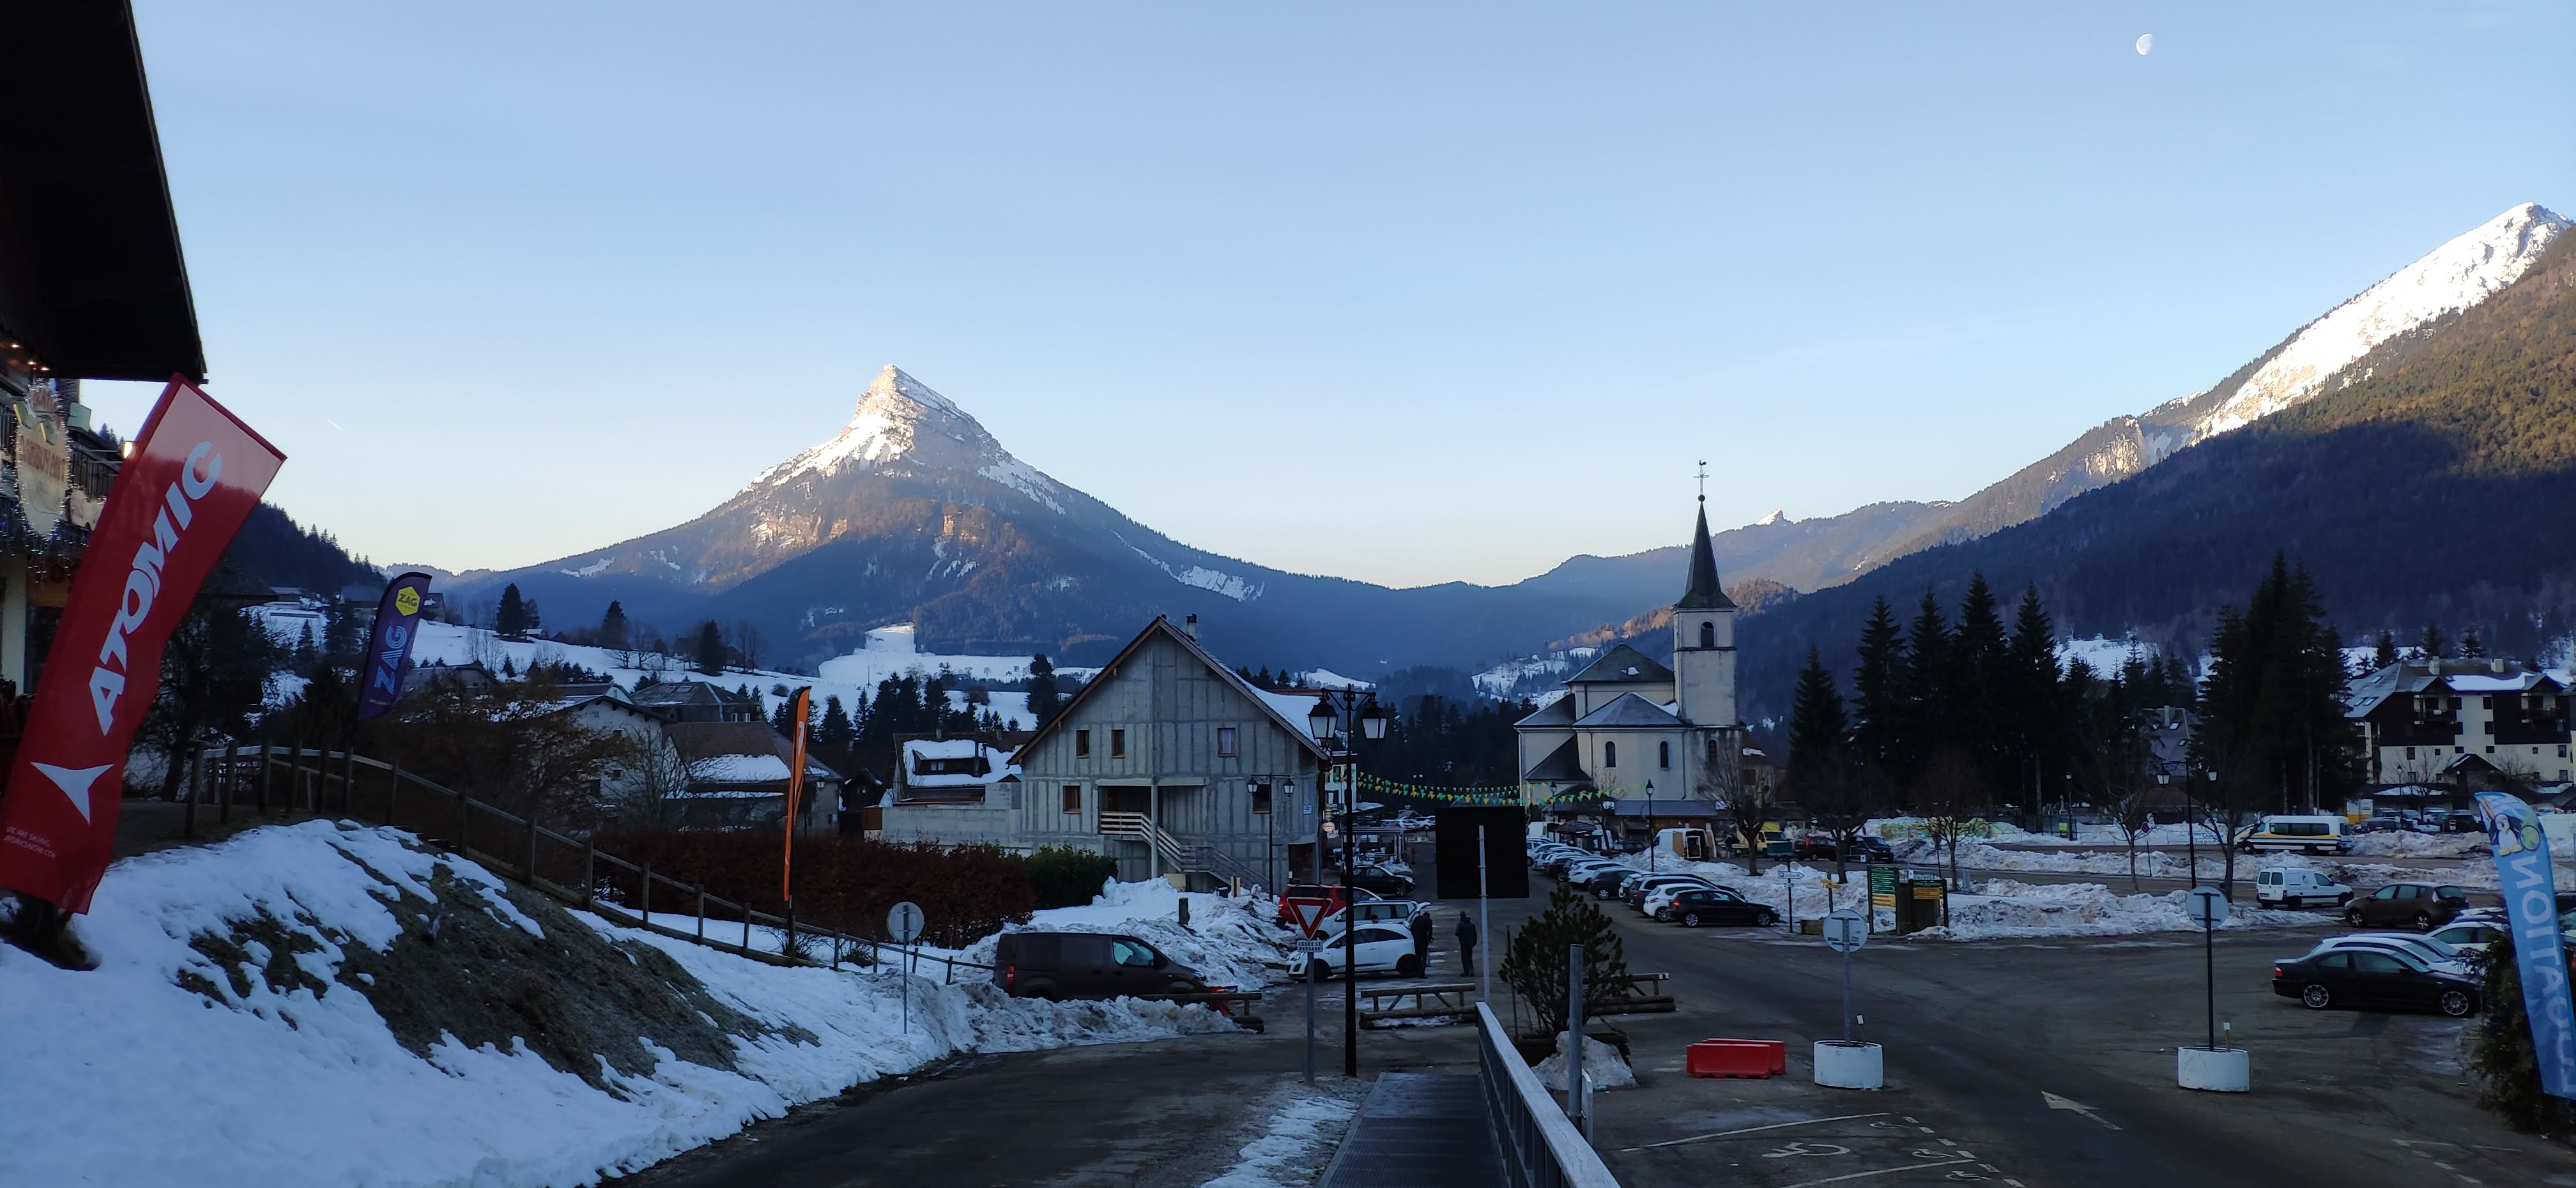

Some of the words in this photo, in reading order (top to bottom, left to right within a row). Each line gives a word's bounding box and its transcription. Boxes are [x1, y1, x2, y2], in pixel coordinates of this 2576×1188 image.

[89, 441, 222, 736] ATOMIC
[399, 593, 418, 607] ZAG
[374, 625, 408, 695] ZAG
